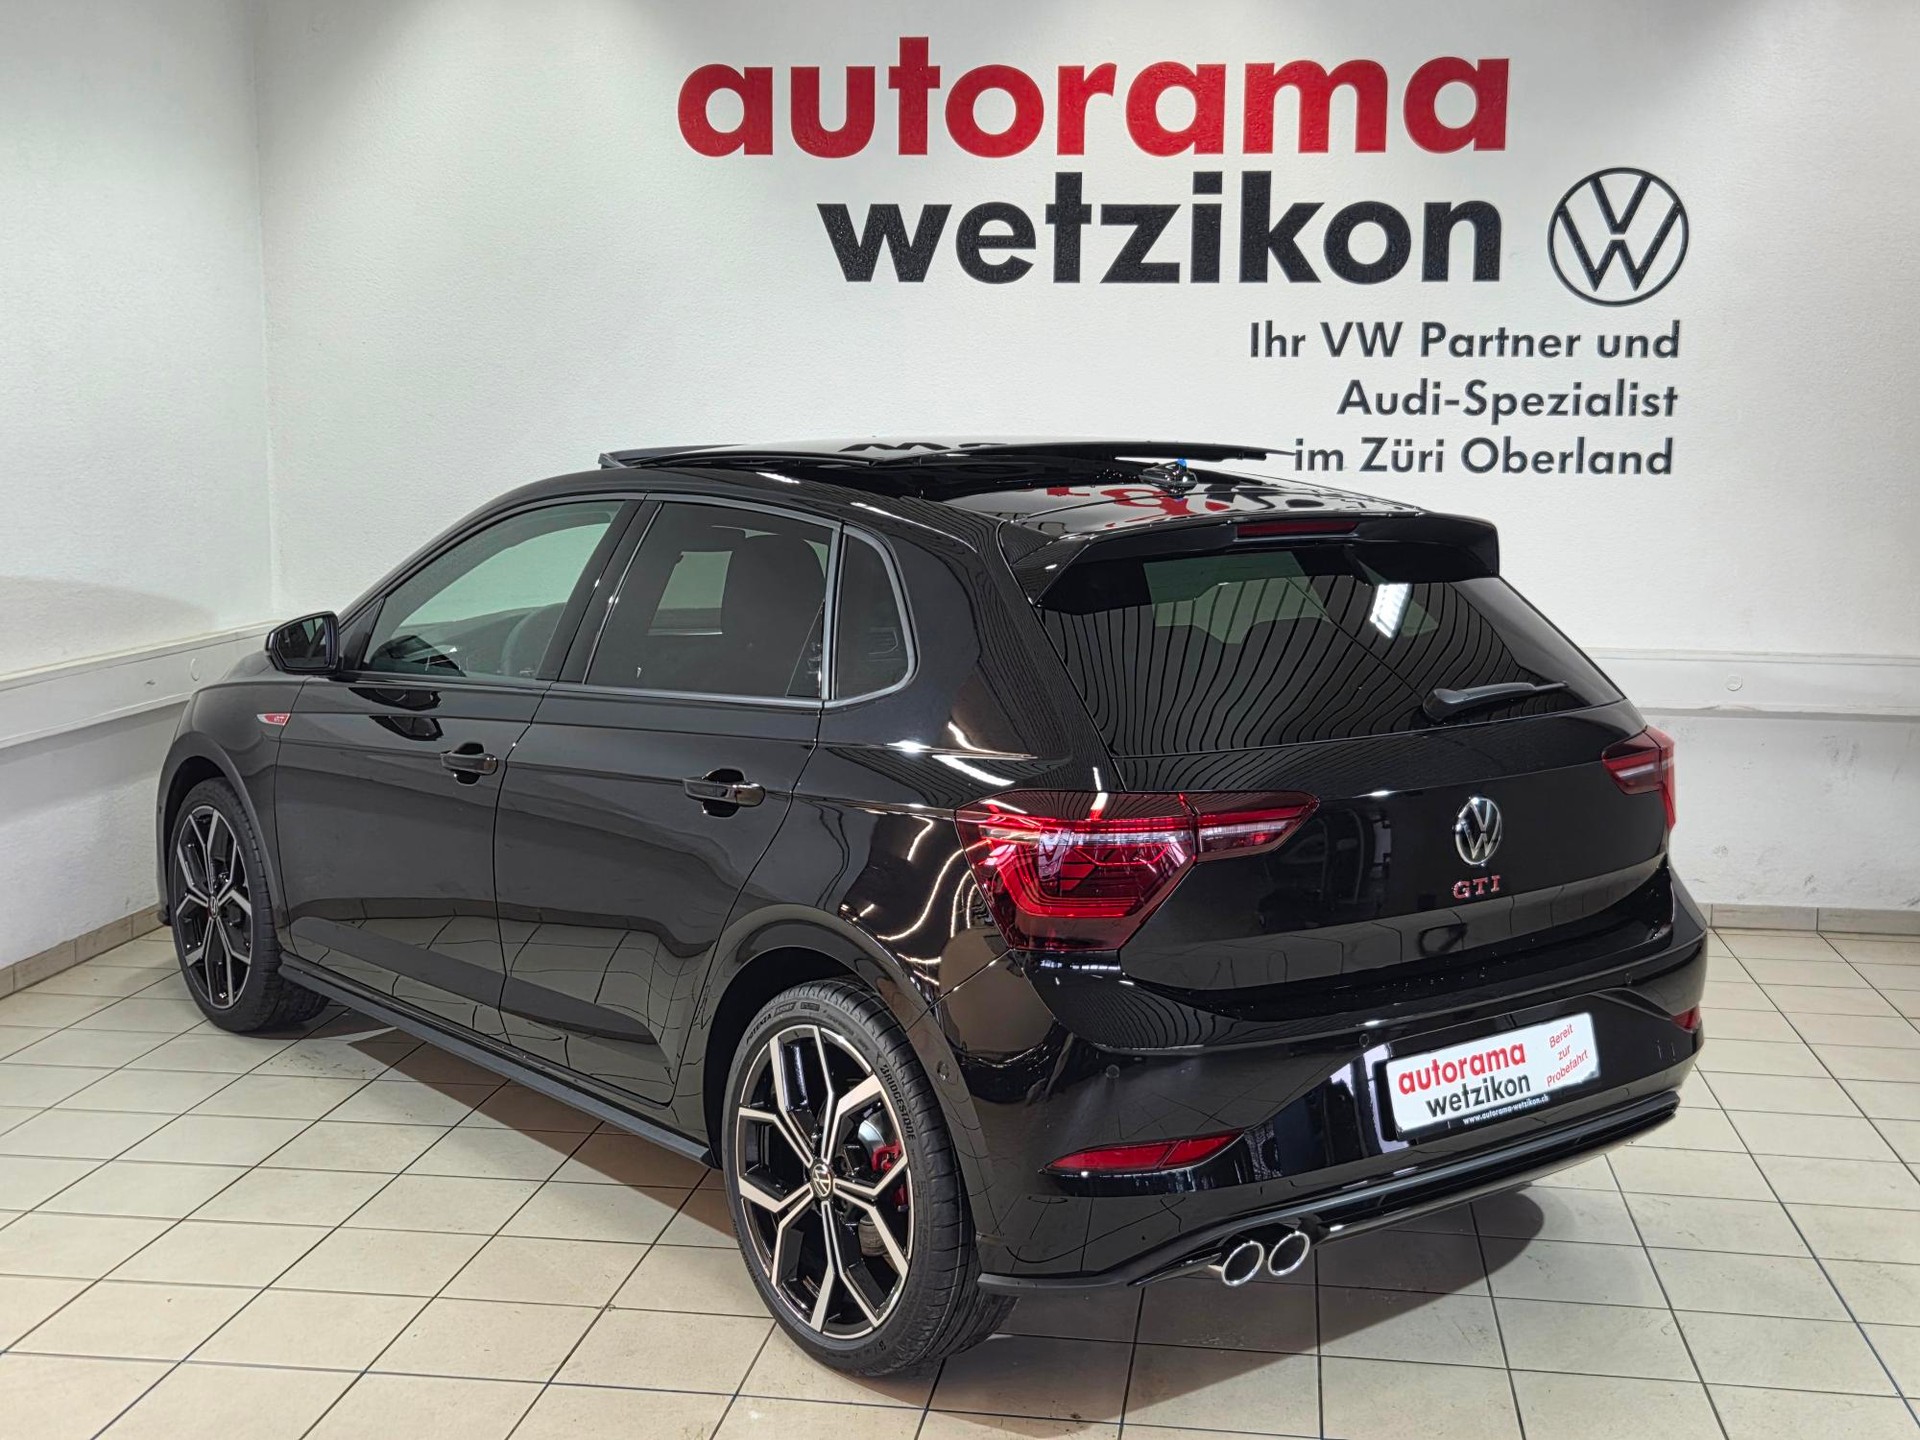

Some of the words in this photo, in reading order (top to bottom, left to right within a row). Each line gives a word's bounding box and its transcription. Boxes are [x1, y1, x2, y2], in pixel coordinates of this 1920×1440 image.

[678, 36, 1508, 158] autorama
[817, 171, 1502, 285] wetzikon
[1548, 168, 1690, 307] VW
[1250, 320, 1306, 358] Ihr
[1320, 321, 1403, 357] VW
[1421, 321, 1581, 358] Partner
[1598, 319, 1680, 358] und
[1337, 377, 1678, 426] Audi-Spezialist
[1294, 438, 1344, 472] im
[1360, 437, 1445, 473] Züri
[1461, 437, 1673, 475] Oberland
[1452, 874, 1501, 900] GTI
[1549, 1023, 1573, 1048] Bereit
[1558, 1043, 1572, 1061] zur
[1398, 1043, 1526, 1095] autorama
[1546, 1049, 1588, 1087] Probefahrt
[879, 1063, 917, 1142] BRIDGESTONE
[1425, 1073, 1531, 1117] wetzikon
[1462, 1094, 1549, 1125] www.autorama-wetzikon.ch
